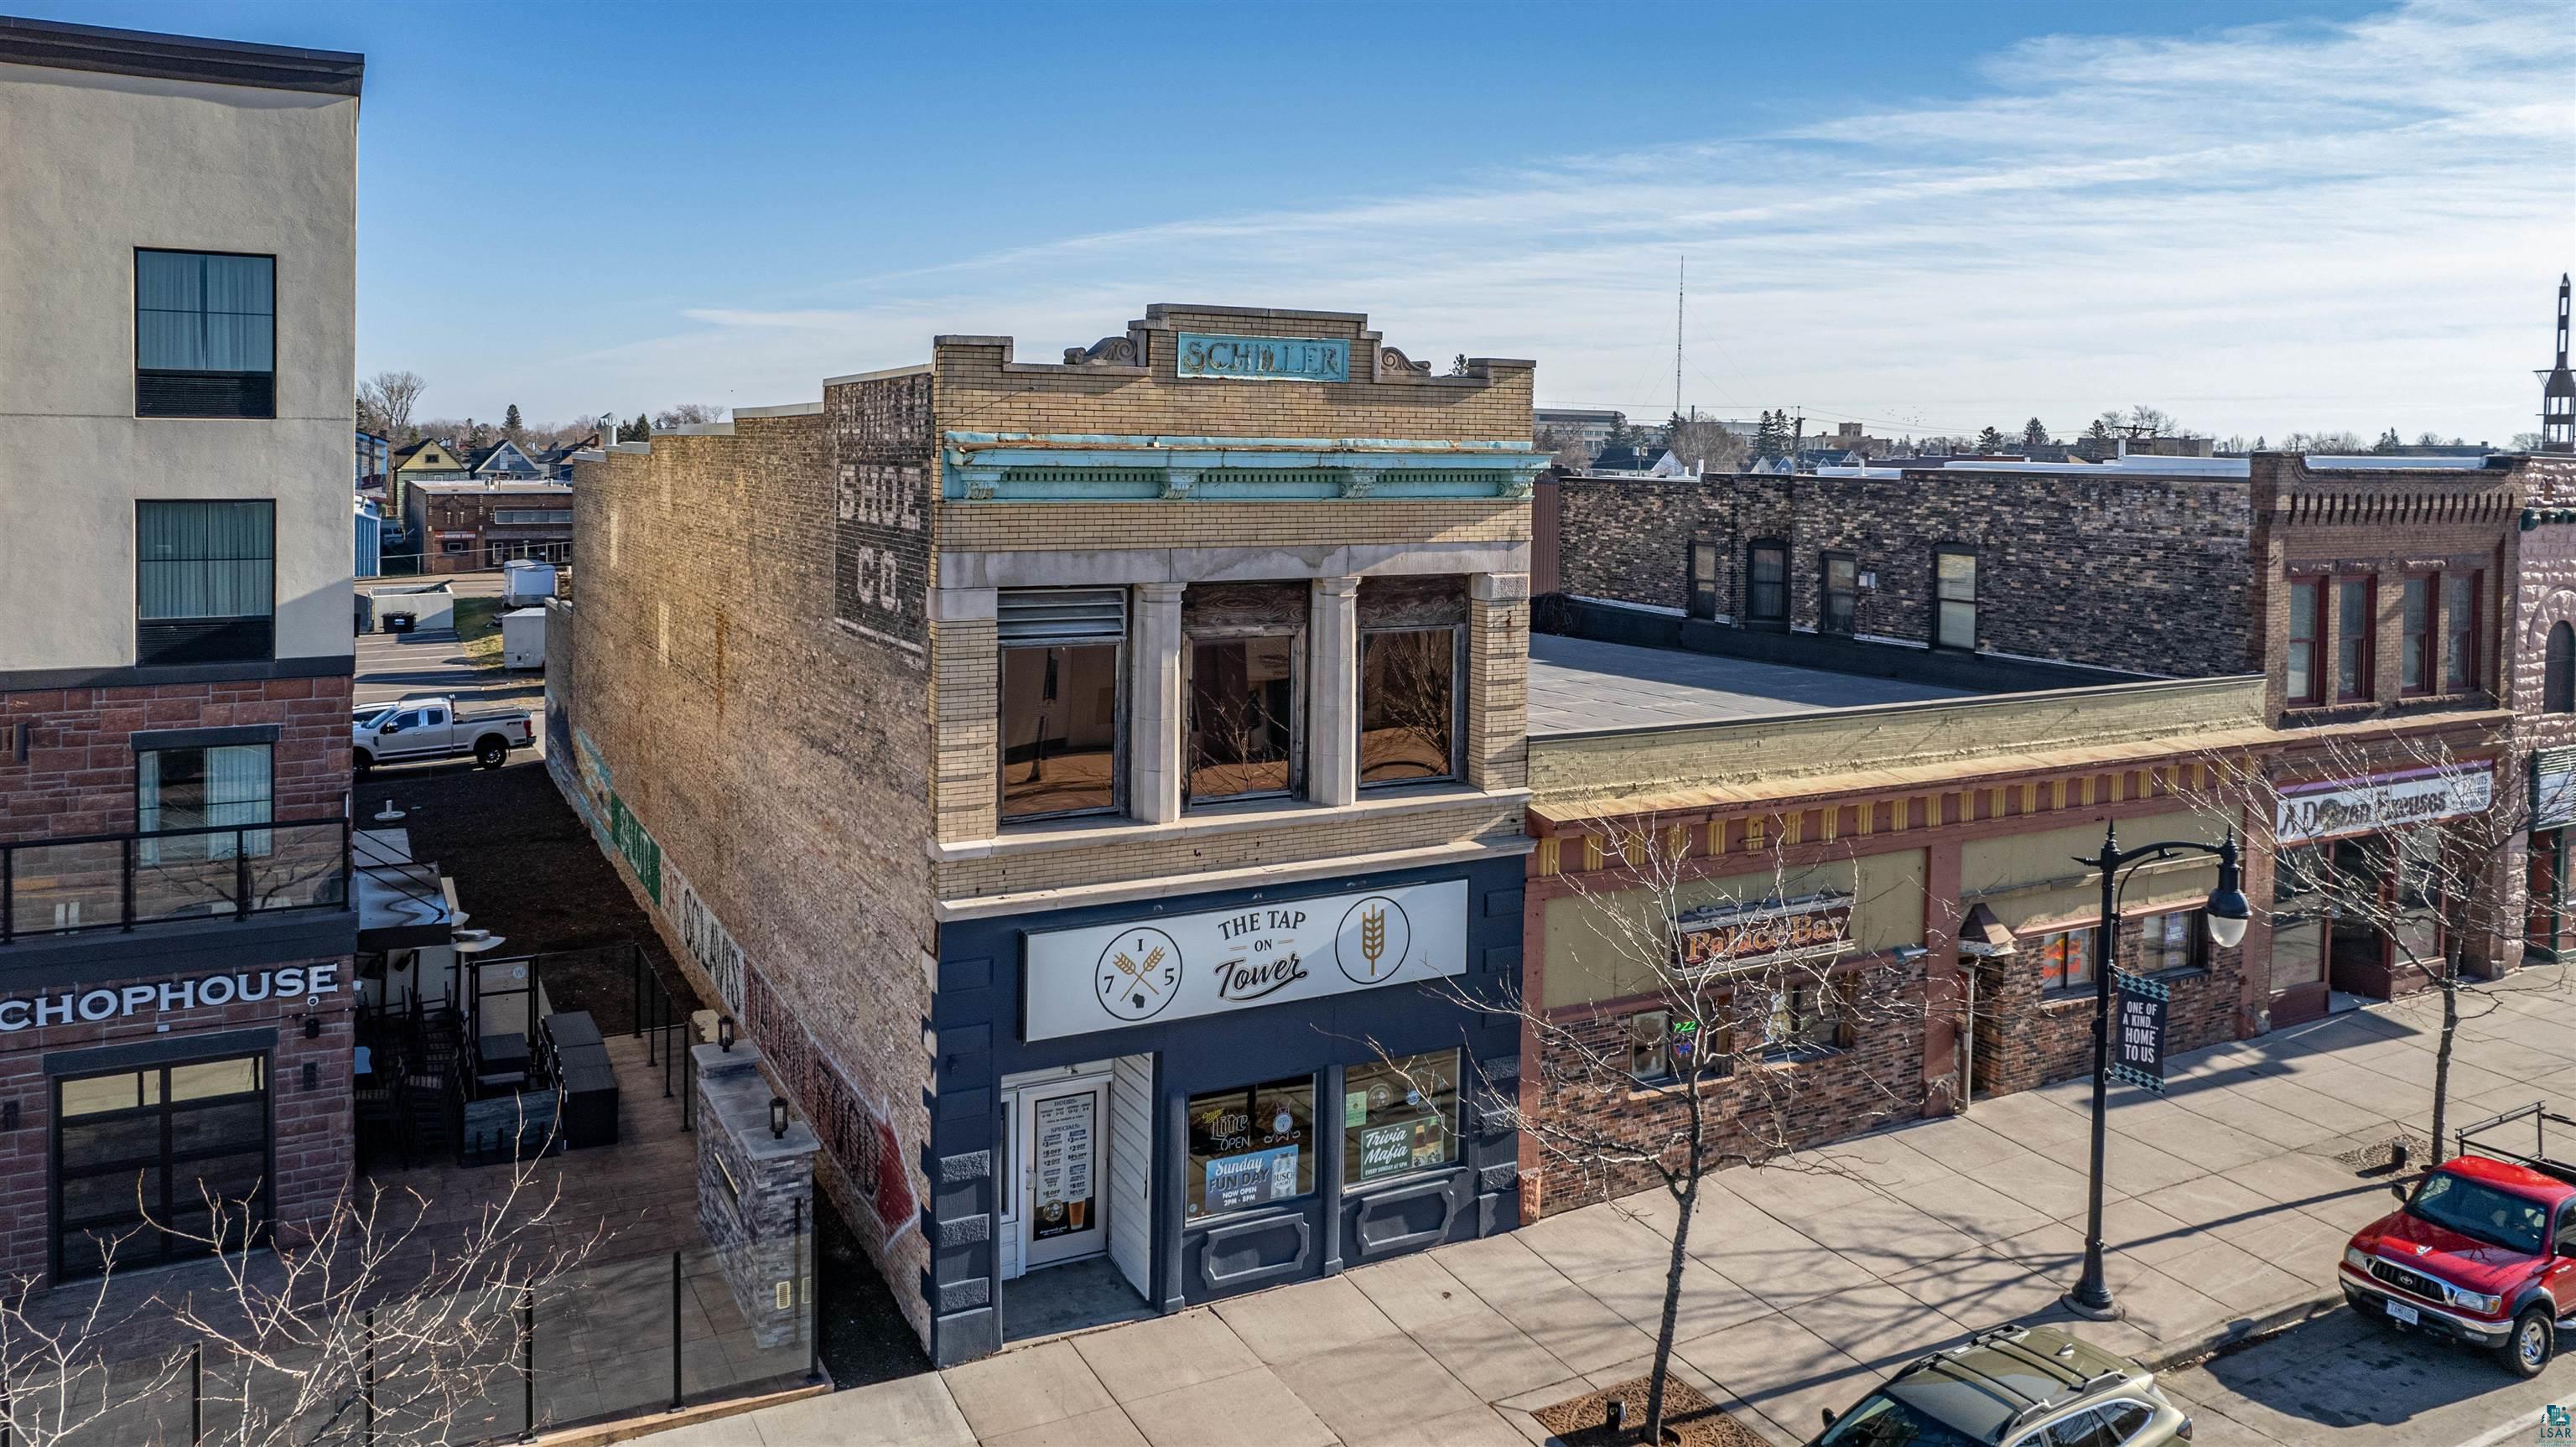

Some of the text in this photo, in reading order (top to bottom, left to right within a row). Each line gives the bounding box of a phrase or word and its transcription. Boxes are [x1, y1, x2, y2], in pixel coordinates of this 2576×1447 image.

[1183, 341, 1340, 374] SCHILLER
[839, 464, 921, 530] SHOE
[1218, 910, 1306, 941] THE TAP
[1254, 939, 1272, 952] ON
[1685, 915, 1843, 962] Palace Bar
[1104, 975, 1114, 994] 7
[1164, 967, 1175, 987] 5
[1214, 952, 1308, 1001] Tower
[0, 962, 338, 1031] CHOPHOUSE
[2127, 1001, 2158, 1016] ONE OF
[2122, 1013, 2159, 1030] A KIND...
[2125, 1027, 2156, 1047] HOME
[2124, 1044, 2155, 1064] TO US
[1211, 1114, 1249, 1140] Lite
[1220, 1135, 1250, 1152] OPEN
[1366, 1127, 1408, 1149] Trivia
[1364, 1143, 1408, 1165] Mafia
[1216, 1157, 1265, 1176] Sunday
[1209, 1168, 1270, 1193] FUN DAY
[1223, 1186, 1257, 1199] NOW OPEN
[1224, 1198, 1237, 1206] 2PM
[1243, 1195, 1256, 1203] 8PM
